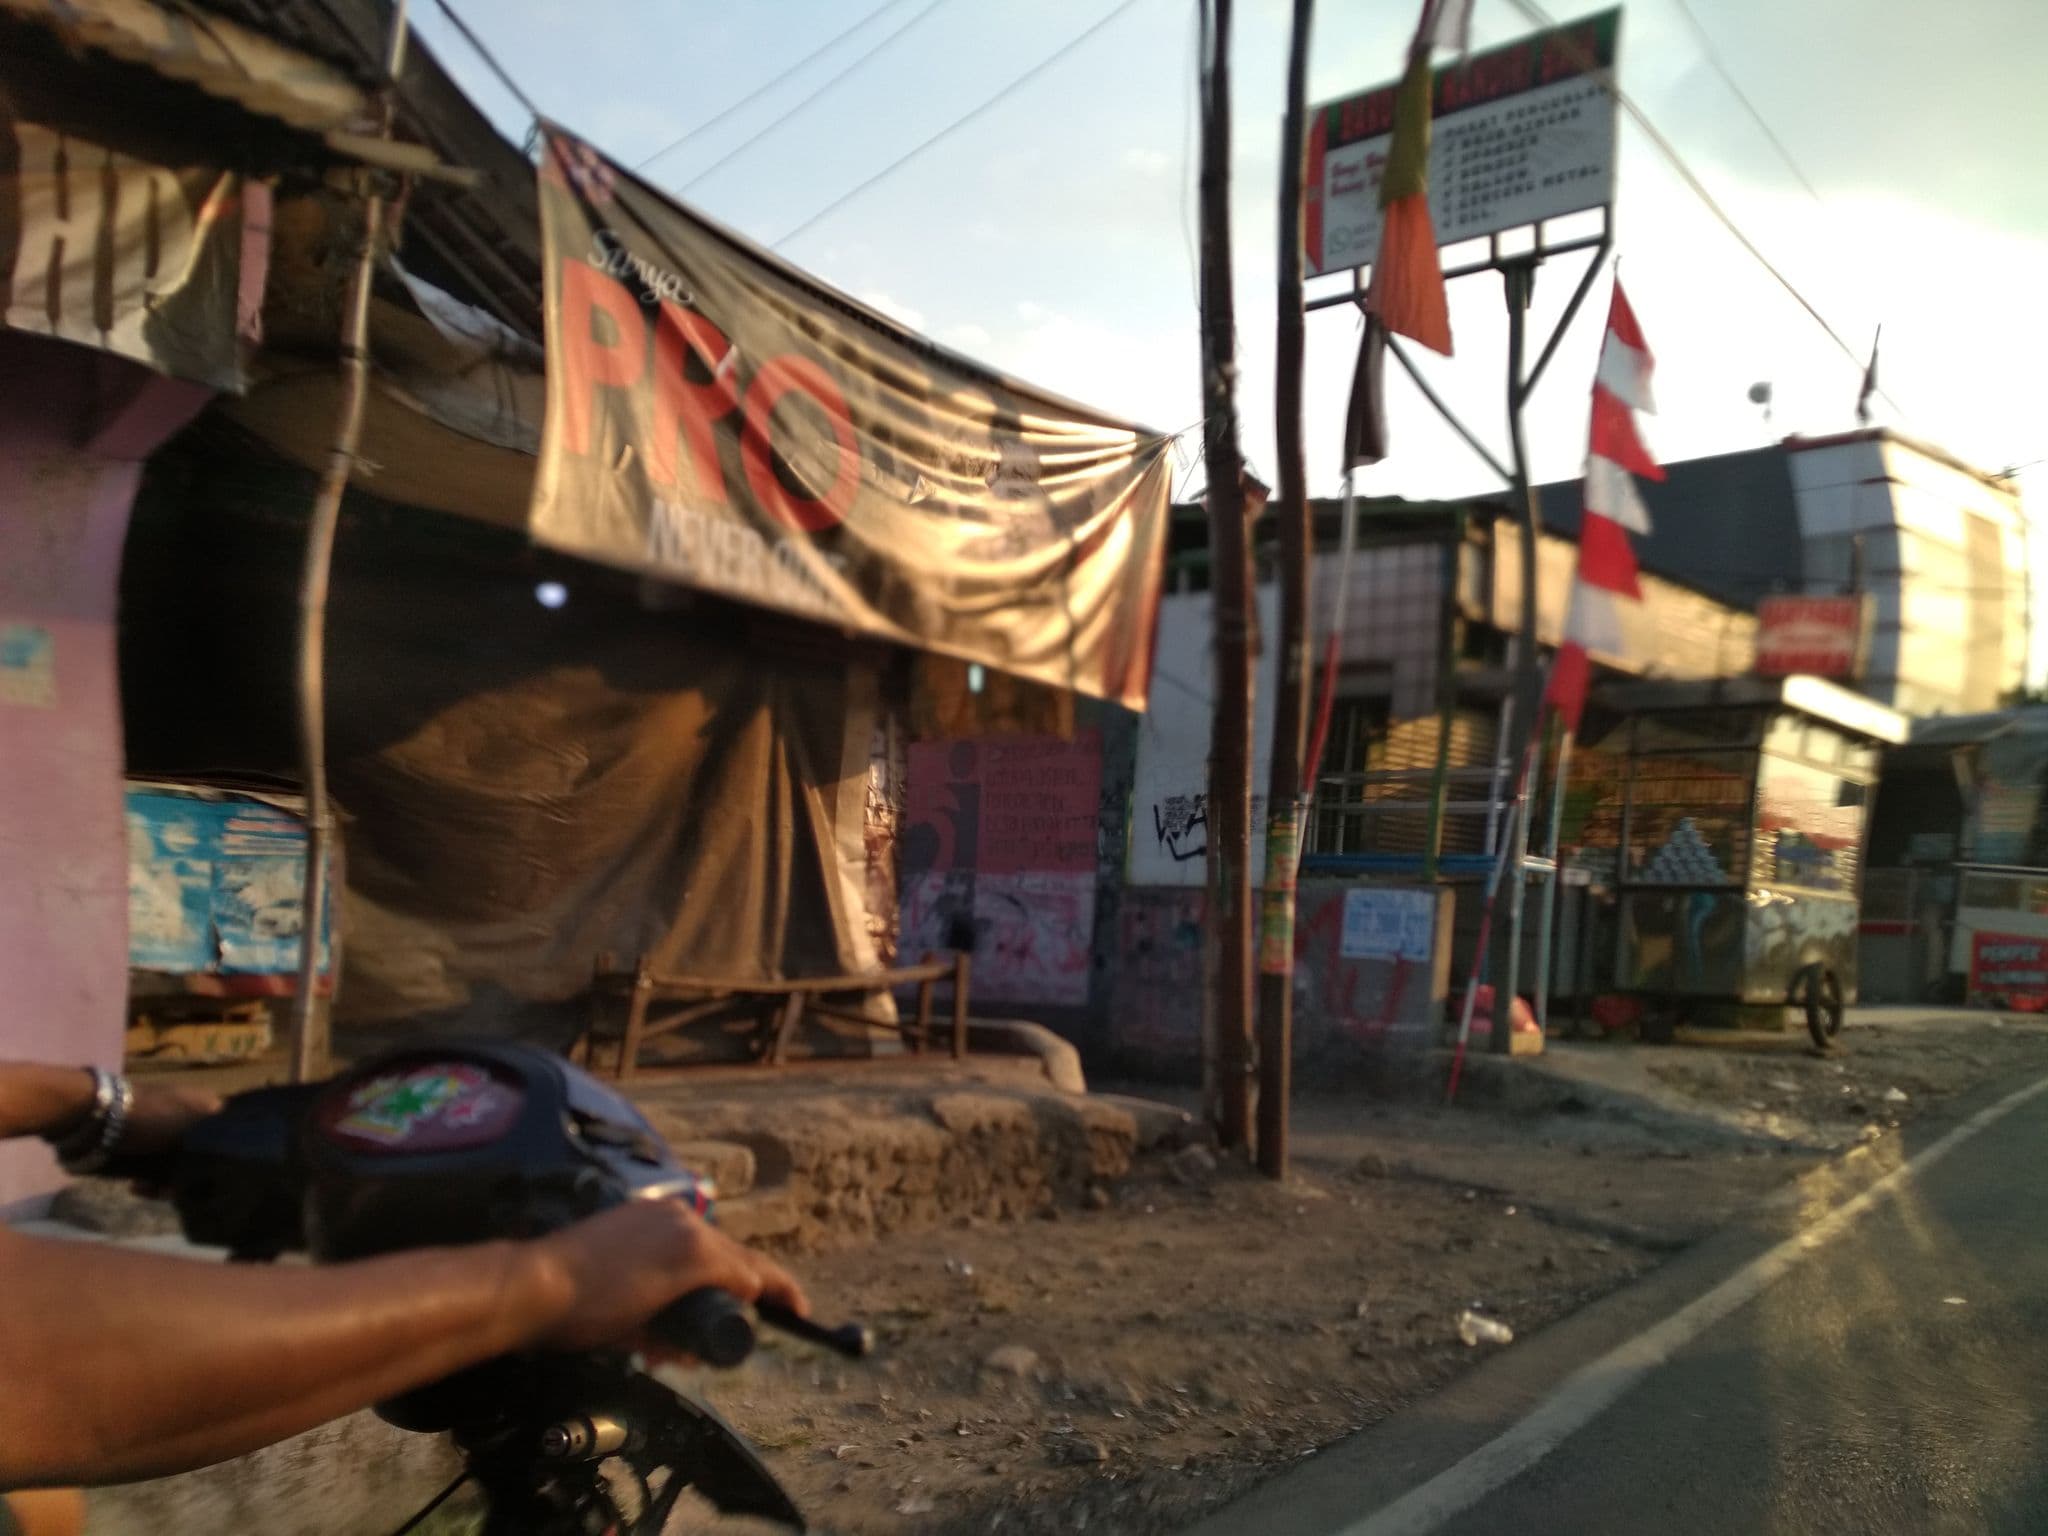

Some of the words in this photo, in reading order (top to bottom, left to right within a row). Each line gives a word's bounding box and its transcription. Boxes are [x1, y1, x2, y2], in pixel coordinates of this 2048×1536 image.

[586, 229, 697, 305] Surya
[561, 256, 861, 532] PRO
[647, 498, 767, 594] NEVER
